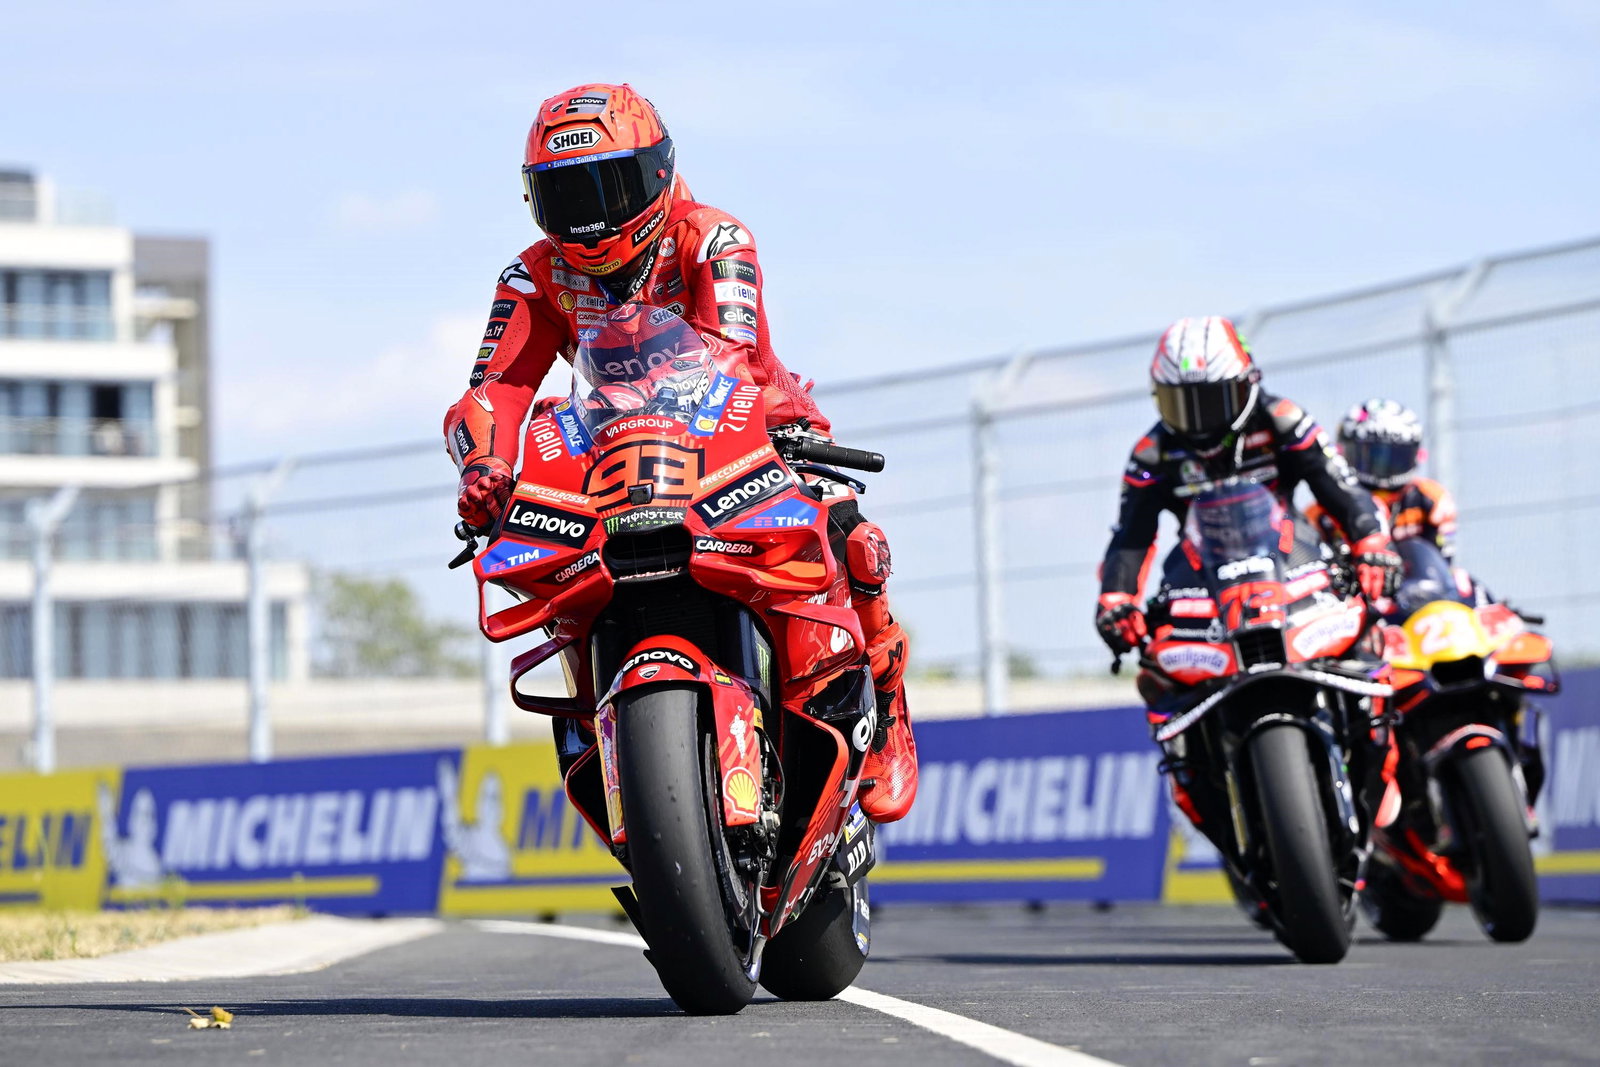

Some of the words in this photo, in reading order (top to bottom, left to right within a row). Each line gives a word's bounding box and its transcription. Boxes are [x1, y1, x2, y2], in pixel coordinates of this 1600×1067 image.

[552, 131, 594, 150] SHOEI
[576, 155, 598, 165] Galicia
[570, 221, 606, 234] Insta360
[634, 210, 664, 243] Lenovo
[631, 256, 654, 294] Lenovo
[652, 305, 682, 324] SHOEI
[723, 308, 757, 329] elica
[726, 385, 762, 422] riello
[605, 418, 674, 439] VARGROUP
[531, 421, 563, 462] riello
[700, 446, 773, 489] FRECCIAROSSA
[518, 483, 591, 505] FRECCIAROSSA
[701, 468, 785, 519] Lenovo
[508, 504, 586, 538] Lenovo
[620, 508, 685, 525] MONSTER
[775, 516, 809, 527] TIM
[507, 548, 540, 566] TIM
[695, 539, 753, 555] CARRERA
[554, 551, 601, 583] CARRERA
[623, 650, 694, 671] enovo
[886, 753, 1162, 846] MICHELIN
[162, 787, 440, 870] MICHELIN
